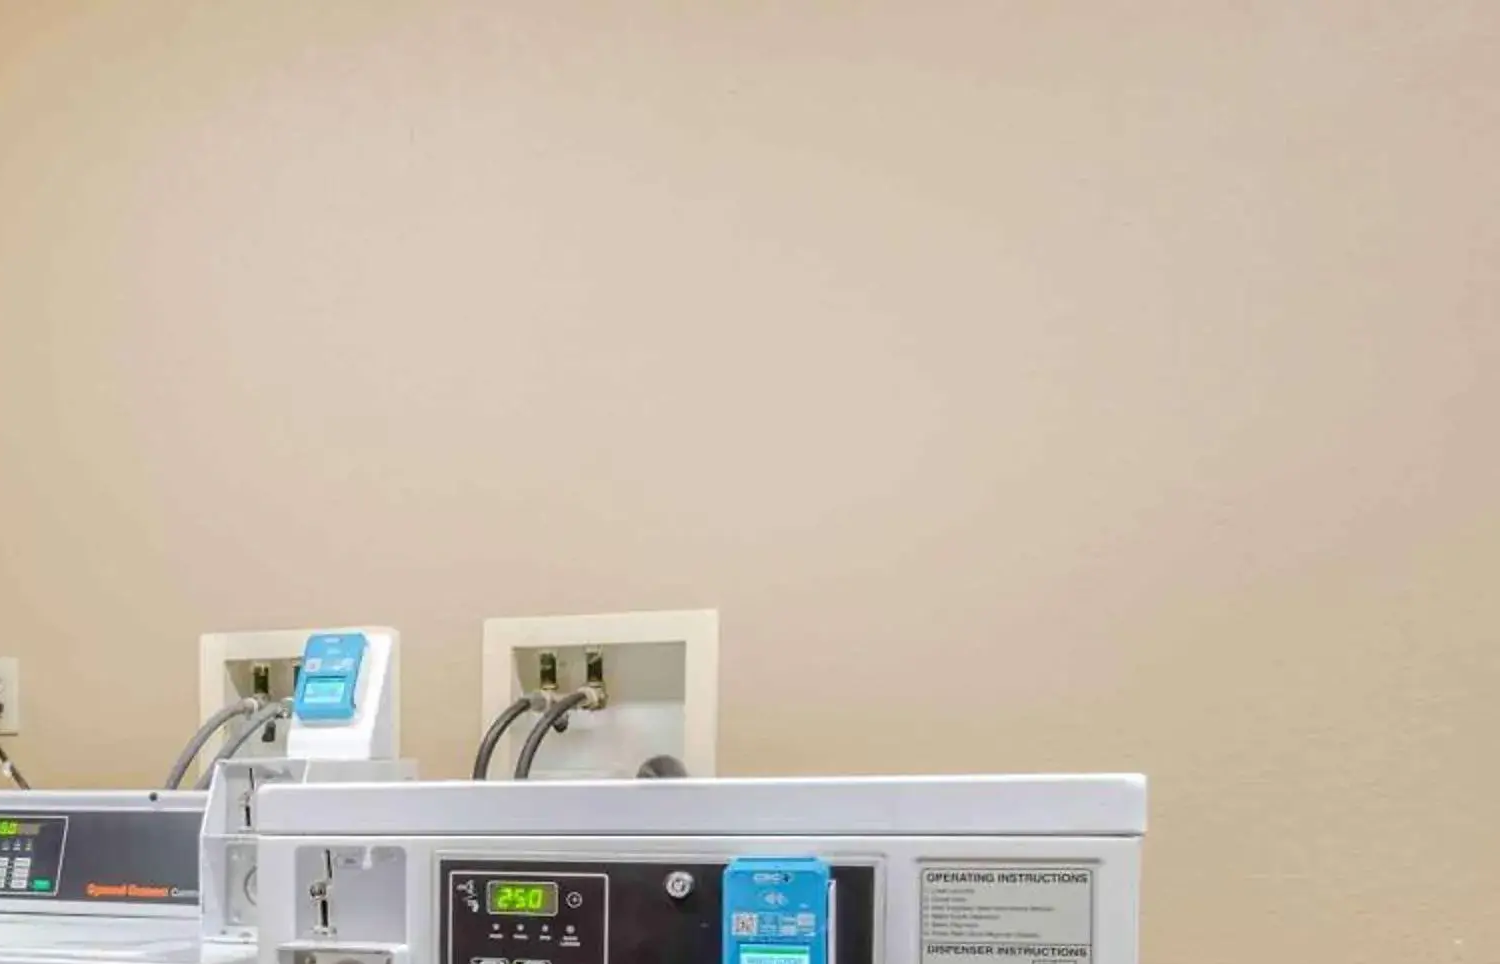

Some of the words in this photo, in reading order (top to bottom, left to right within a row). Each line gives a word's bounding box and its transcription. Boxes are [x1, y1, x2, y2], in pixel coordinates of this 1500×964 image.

[926, 872, 995, 884] OPERATING
[998, 872, 1088, 884] INSTRUCTIONS
[496, 887, 543, 909] 250
[926, 944, 993, 956] DISPENSER
[998, 946, 1088, 958] INSTRUCTIONS
